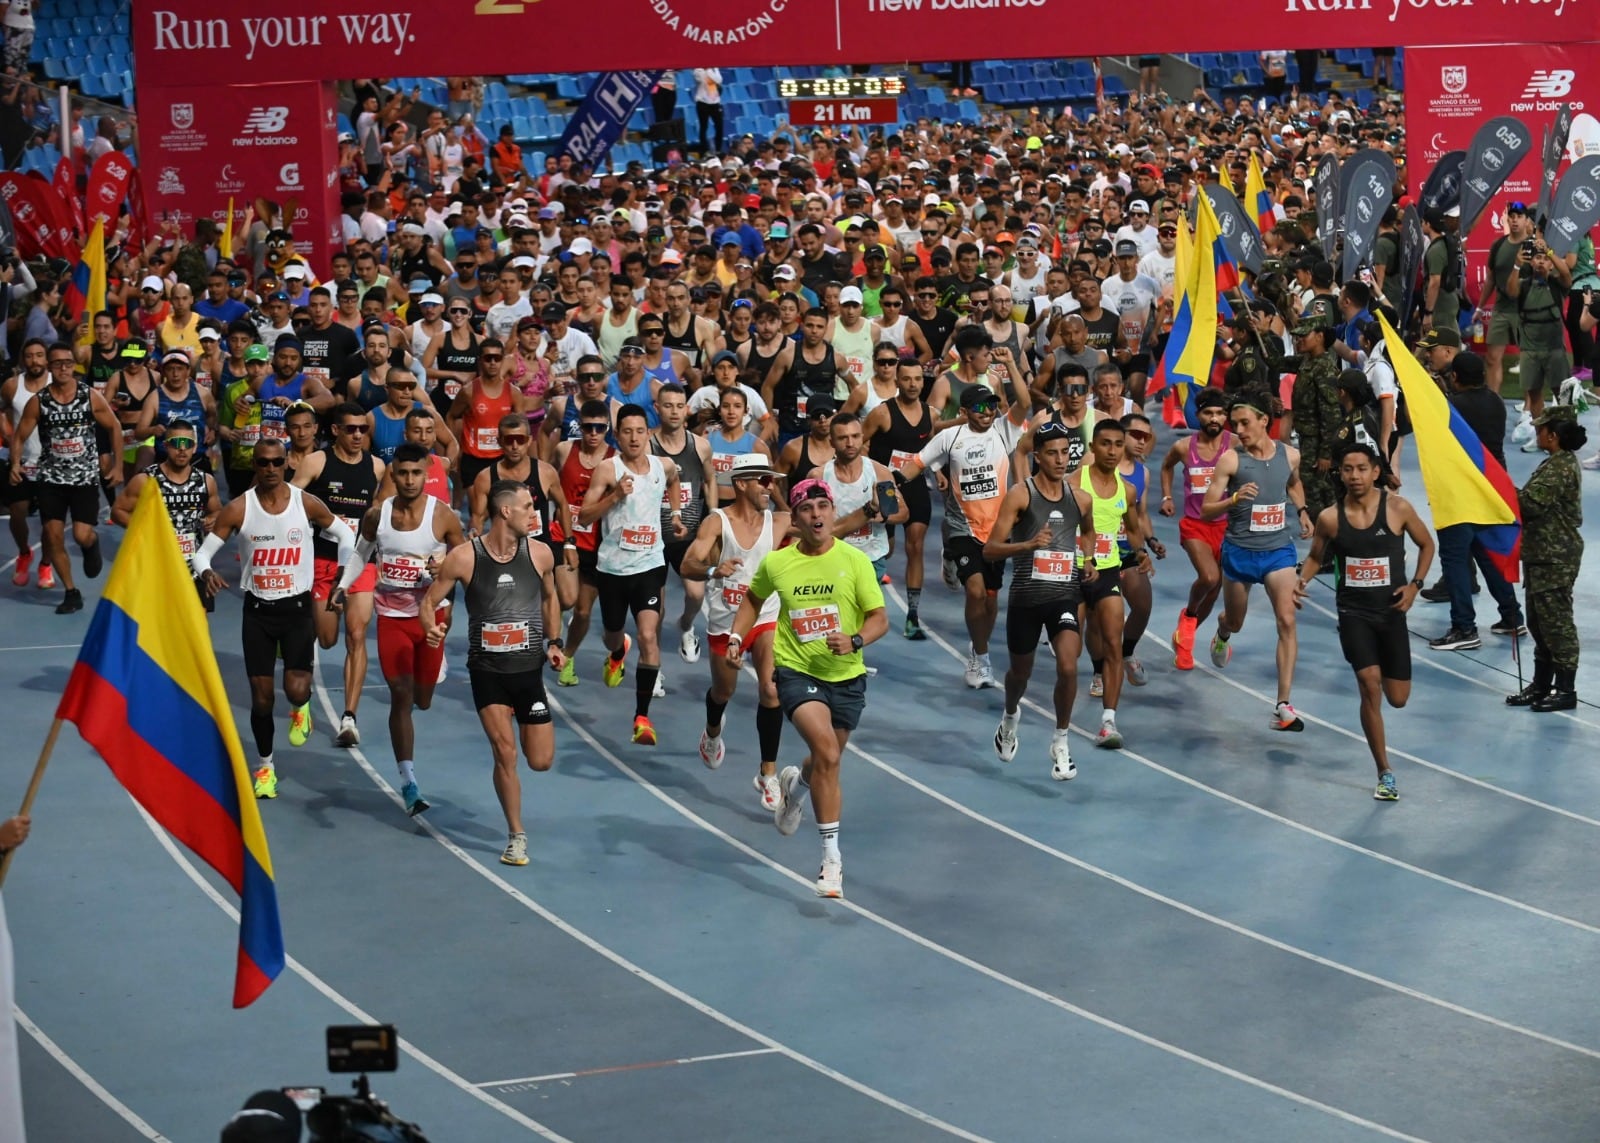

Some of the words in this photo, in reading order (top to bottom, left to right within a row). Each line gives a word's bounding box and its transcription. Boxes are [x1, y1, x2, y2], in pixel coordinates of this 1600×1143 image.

[683, 11, 774, 45] MARATÓN
[153, 11, 232, 50] Run
[241, 15, 327, 60] your
[337, 13, 415, 56] way.
[814, 104, 834, 121] 21
[841, 103, 872, 121] Km
[1511, 103, 1534, 112] new
[1536, 101, 1584, 111] balace
[232, 137, 253, 147] new
[255, 135, 298, 146] balance
[1495, 126, 1522, 150] 0:50
[1368, 175, 1385, 198] 1:10
[447, 356, 476, 364] FOCUS
[49, 411, 84, 421] CARLOS
[962, 464, 994, 476] DIEGO
[965, 481, 994, 494] 15953
[328, 495, 367, 506] COLOMBIA
[1261, 513, 1281, 524] 417
[631, 533, 652, 544] 448
[253, 547, 301, 567] RUN
[387, 567, 417, 580] 2222
[1048, 562, 1063, 573] 18
[1355, 568, 1379, 579] 282
[262, 578, 285, 588] 184
[793, 584, 834, 596] KEVIN
[802, 618, 829, 632] 104
[501, 634, 510, 644] 7
